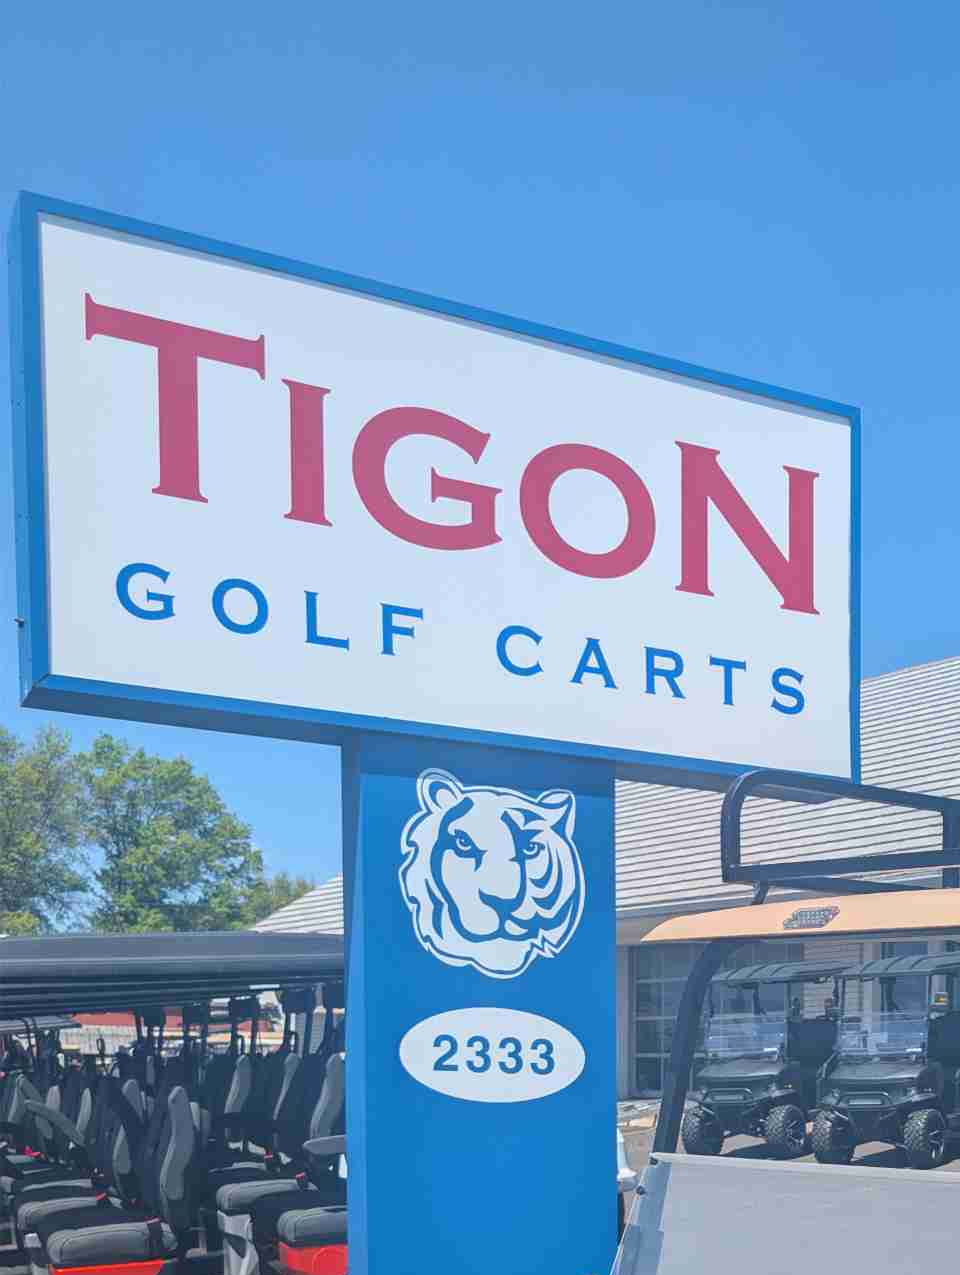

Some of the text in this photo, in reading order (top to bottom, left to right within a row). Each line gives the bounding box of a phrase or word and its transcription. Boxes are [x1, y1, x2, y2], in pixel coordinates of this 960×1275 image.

[84, 292, 820, 616] TIGON
[115, 562, 806, 716] GOLF CARTS
[432, 1033, 556, 1076] 2333
